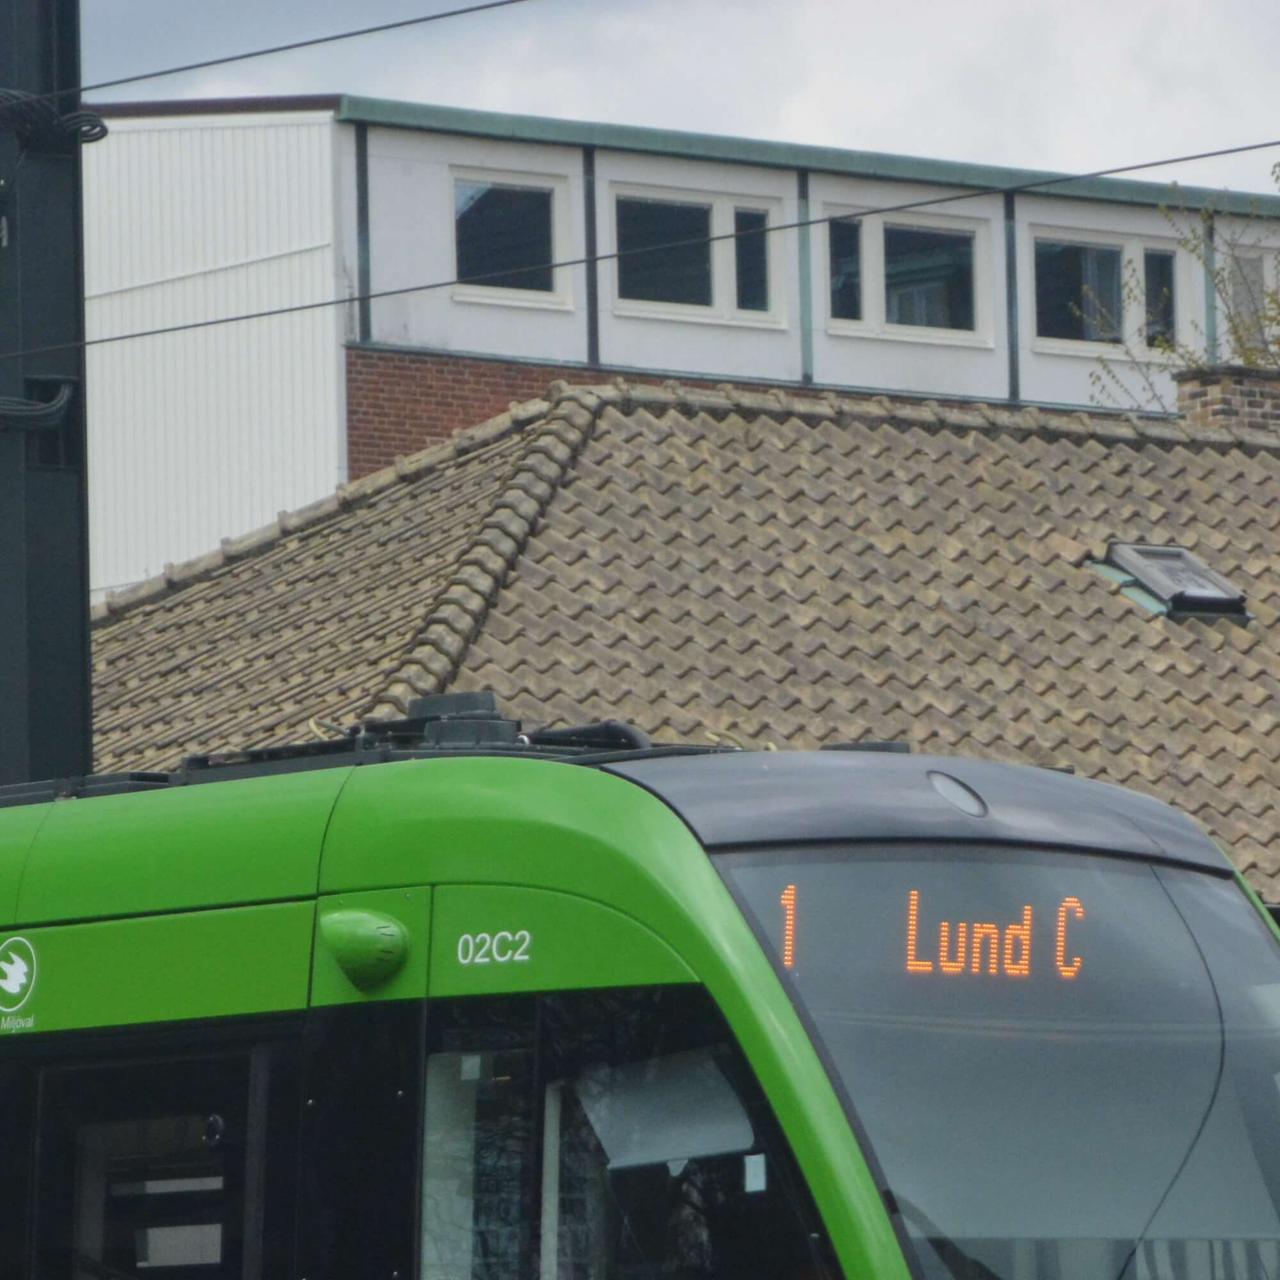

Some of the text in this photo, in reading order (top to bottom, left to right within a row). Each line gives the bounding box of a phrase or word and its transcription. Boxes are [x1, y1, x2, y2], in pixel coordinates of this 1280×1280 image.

[456, 929, 533, 967] 02C2
[781, 884, 1085, 978] 1 Lund C
